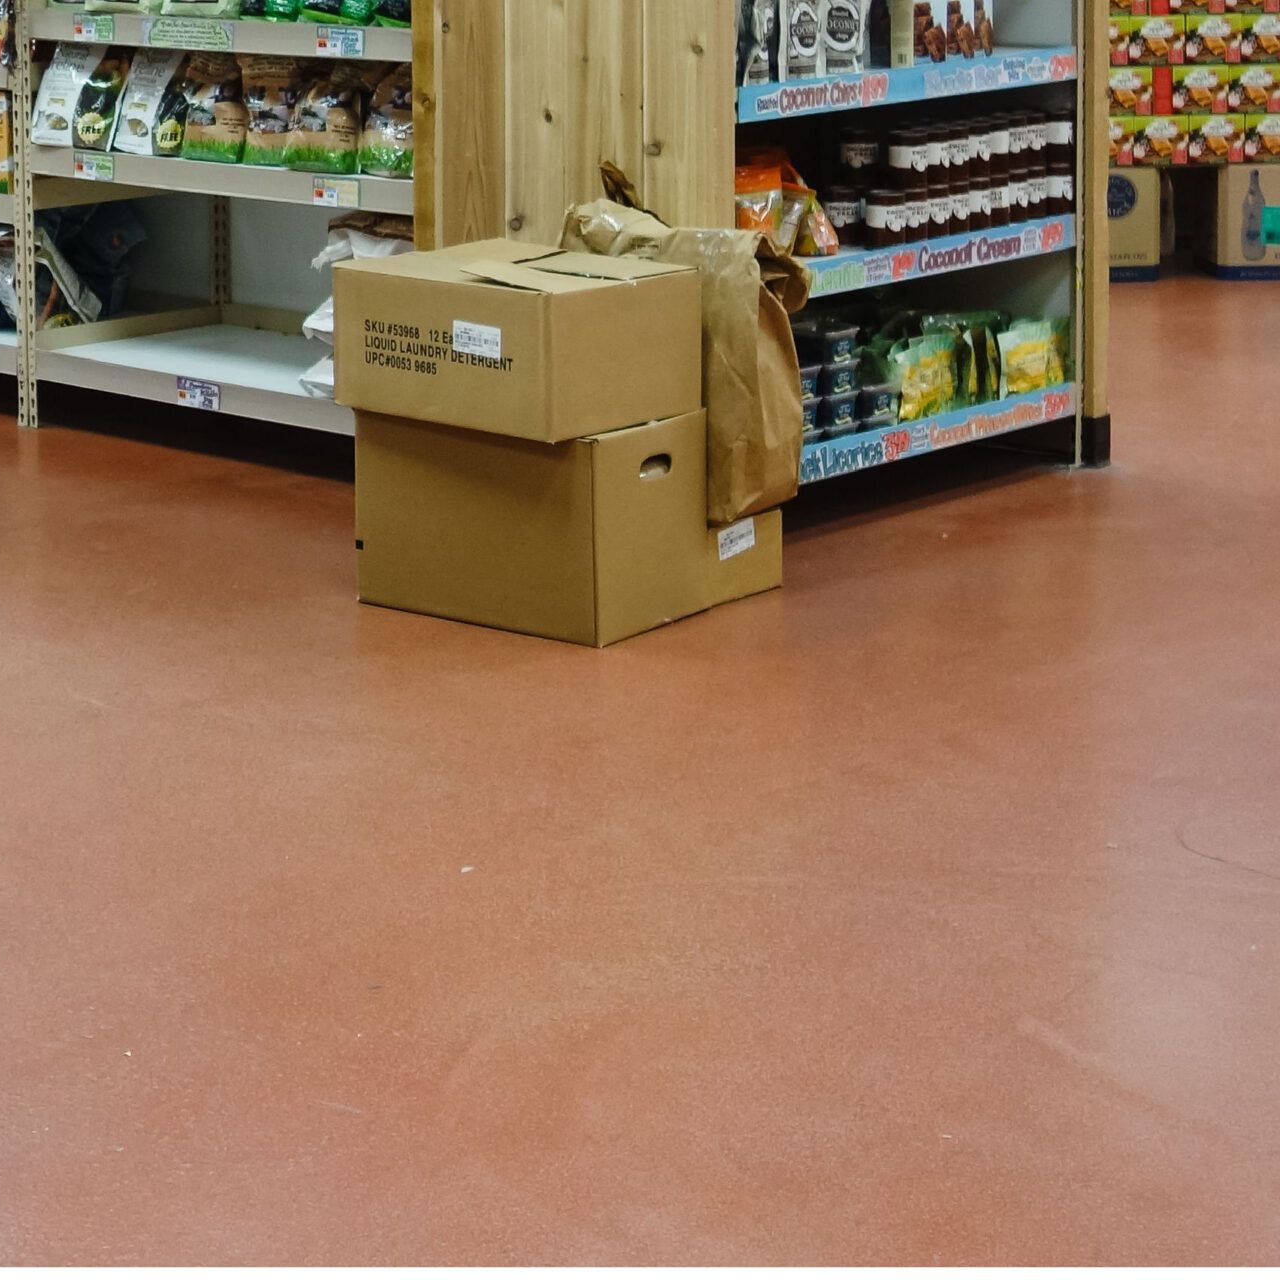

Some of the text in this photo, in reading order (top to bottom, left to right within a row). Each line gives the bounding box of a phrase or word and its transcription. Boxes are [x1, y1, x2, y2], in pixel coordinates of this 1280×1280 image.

[779, 80, 859, 115] Coconut Chips
[918, 239, 976, 273] Coconut
[977, 235, 1022, 263] Cream
[364, 319, 385, 334] SKU
[387, 324, 420, 339] #53968
[429, 330, 440, 343] 12
[365, 335, 513, 373] LIQUID LAUNDRY DETERGENT
[414, 362, 437, 376] 9685
[820, 440, 884, 478] Licorice
